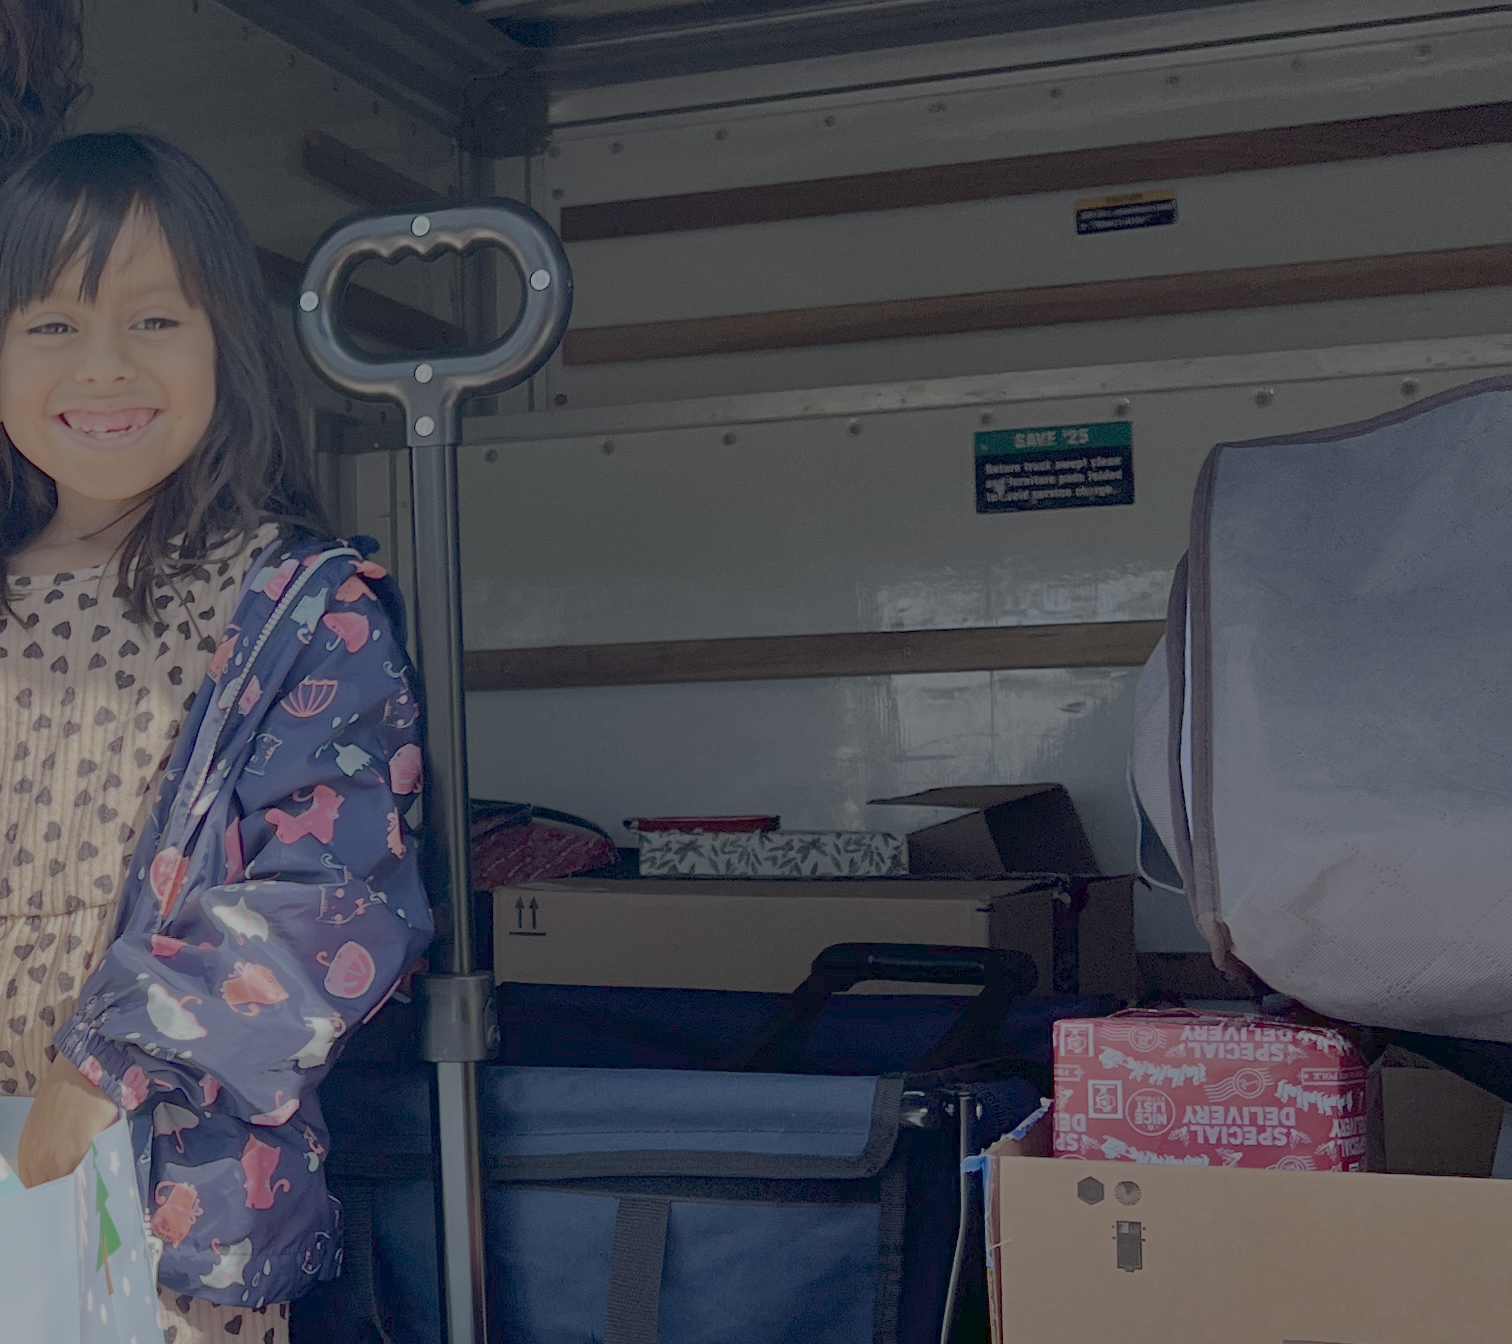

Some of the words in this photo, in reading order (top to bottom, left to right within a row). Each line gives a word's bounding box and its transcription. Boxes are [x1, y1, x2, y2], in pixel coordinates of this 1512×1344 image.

[1014, 431, 1056, 448] SAVE
[1188, 1042, 1285, 1062] SPECIAL
[1136, 1101, 1166, 1114] LIST
[1182, 1105, 1296, 1126] DELIVERY
[1135, 1113, 1167, 1125] NICE
[1188, 1126, 1288, 1146] SPECIAL
